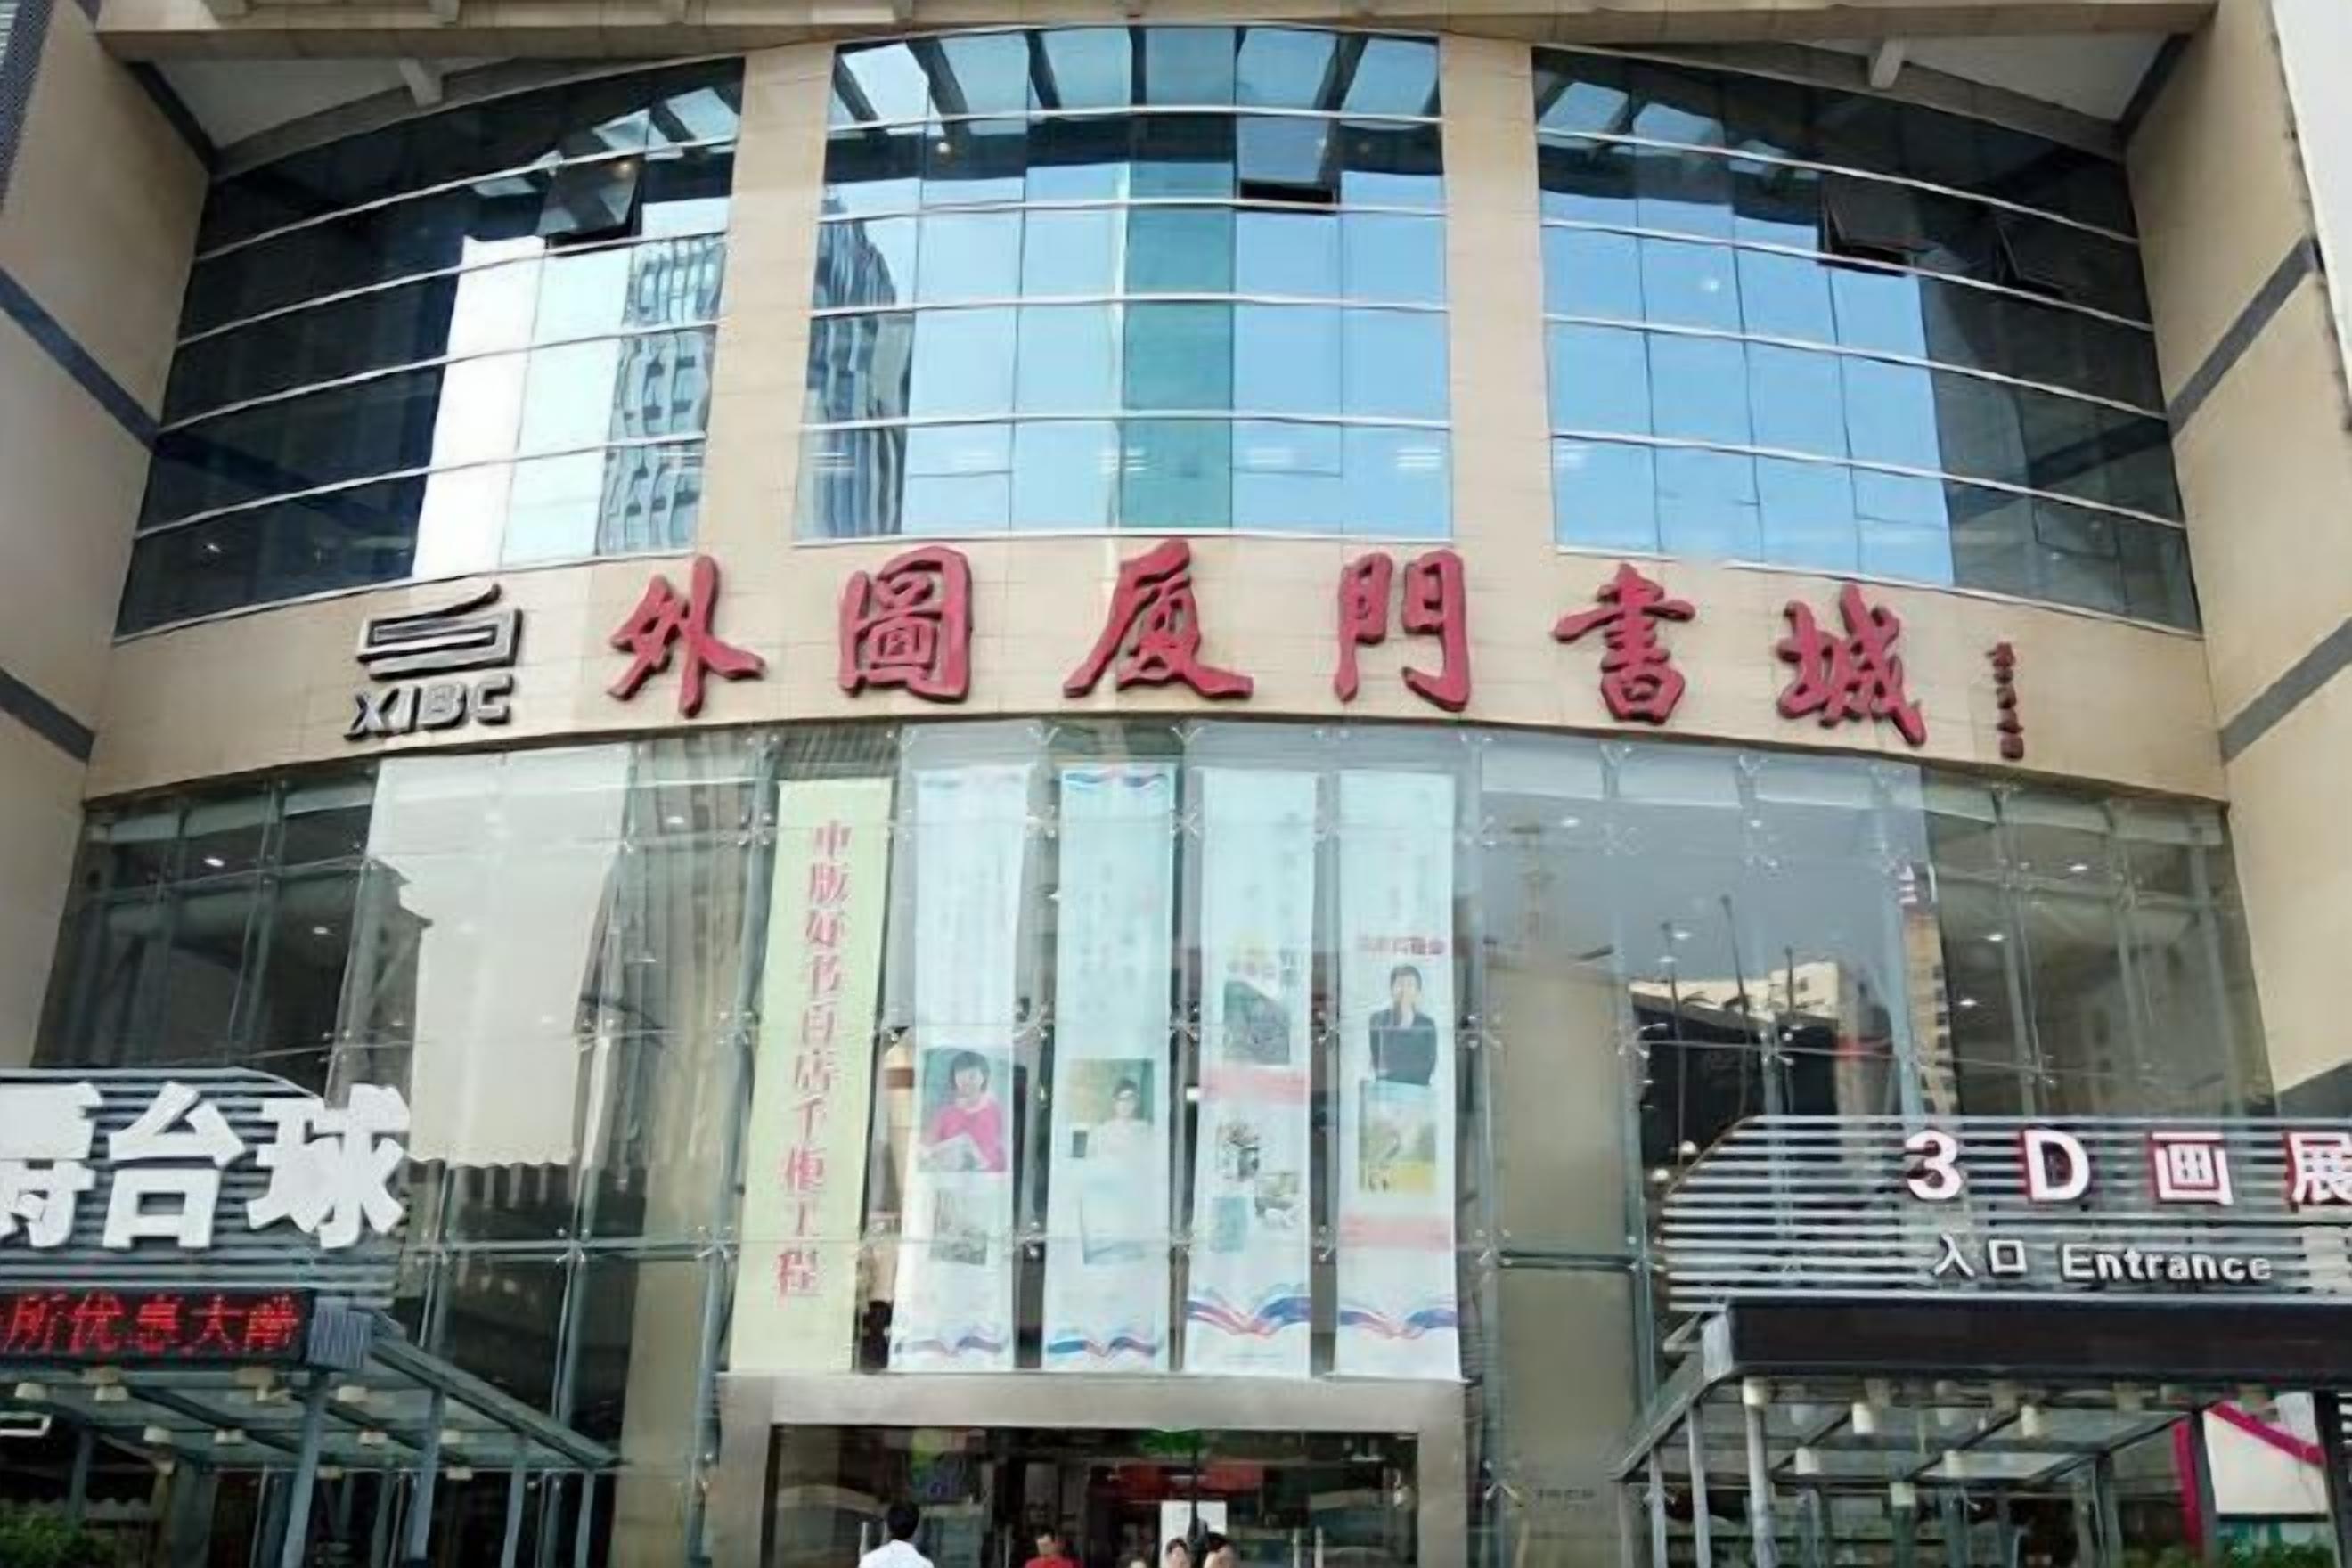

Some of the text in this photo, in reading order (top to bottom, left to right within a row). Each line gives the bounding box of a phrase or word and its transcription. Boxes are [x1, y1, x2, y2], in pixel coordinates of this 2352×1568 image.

[344, 675, 513, 741] XIBC
[1933, 1234, 2273, 1281] 入口 Entrance
